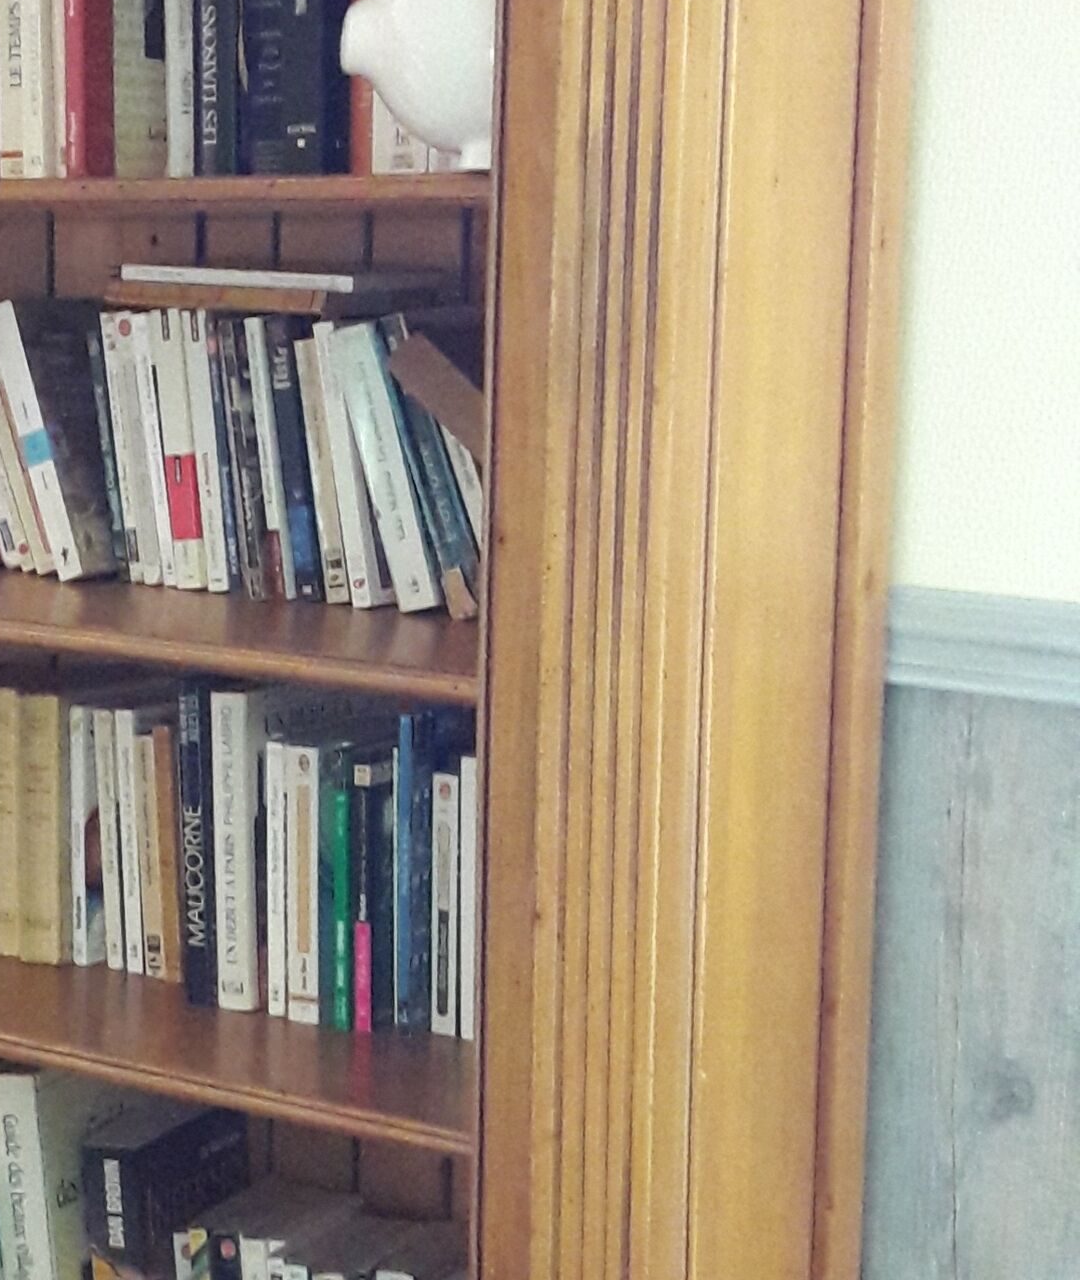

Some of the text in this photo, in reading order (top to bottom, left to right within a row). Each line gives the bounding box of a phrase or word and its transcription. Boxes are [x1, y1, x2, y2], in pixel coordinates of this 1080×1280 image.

[7, 0, 22, 62] TEMPS
[201, 5, 217, 103] LIAISONS
[8, 65, 22, 89] LE
[201, 109, 217, 146] LES
